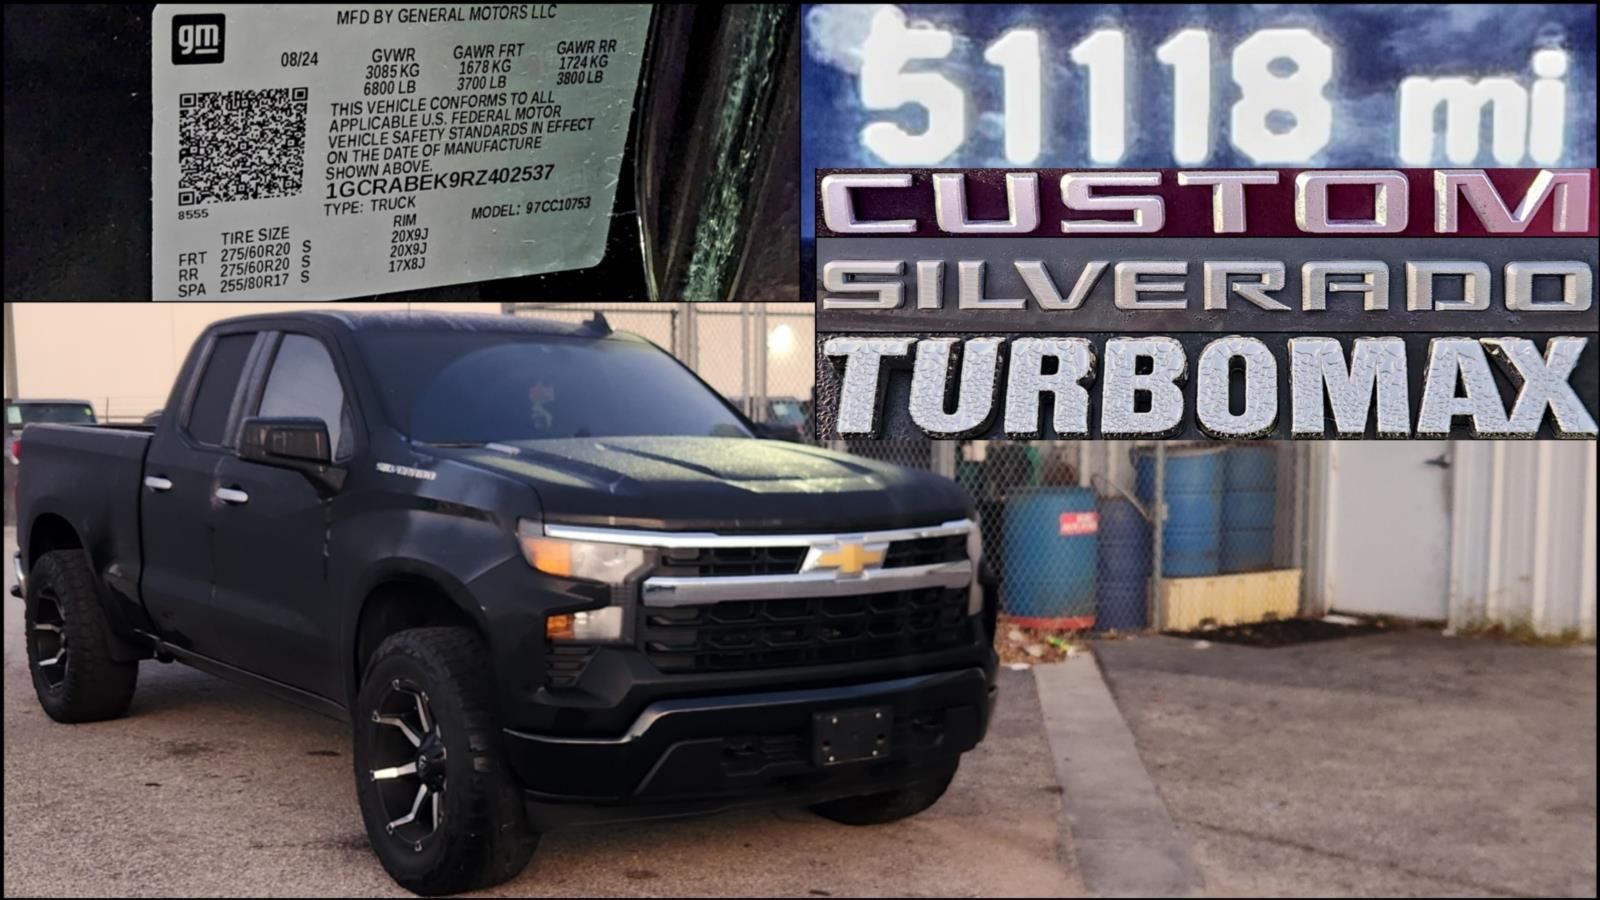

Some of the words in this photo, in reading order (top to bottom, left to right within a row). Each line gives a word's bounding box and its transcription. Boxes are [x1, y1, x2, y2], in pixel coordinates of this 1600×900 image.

[337, 10, 370, 25] MFD
[373, 9, 394, 24] BY
[398, 7, 465, 23] GENERAL
[469, 5, 528, 21] MOTORS
[531, 4, 557, 19] LLC
[178, 24, 219, 55] gm
[557, 40, 595, 55] GAWR
[598, 39, 617, 54] RR
[281, 51, 319, 67] 08/24
[372, 48, 416, 63] GVWR
[453, 44, 495, 59] GAWR
[498, 43, 525, 58] FRT
[365, 64, 398, 79] 3085
[400, 63, 420, 78] KG
[459, 60, 489, 75] 1678
[492, 59, 512, 73] KG
[559, 56, 588, 70] 1724
[590, 54, 609, 69] KG
[363, 81, 395, 96] 6800
[398, 80, 416, 94] LB
[457, 76, 487, 91] 3700
[489, 75, 507, 89] LB
[556, 71, 585, 86] 3800
[587, 70, 603, 84] LB
[861, 15, 1334, 166] 51118
[1399, 49, 1567, 166] mi
[330, 101, 363, 117] THIS
[367, 98, 427, 114] VEHICLE
[430, 93, 507, 110] CONFORMS
[511, 91, 528, 105] TO
[530, 90, 555, 104] ALL
[329, 114, 418, 133] APPLICABLE
[421, 112, 448, 127] U.S.
[451, 109, 511, 124] FEDERAL
[515, 105, 562, 120] MOTOR
[328, 131, 389, 149] VEHICLE
[392, 128, 445, 144] SAFETY
[449, 122, 528, 140] STANDARDS
[531, 121, 543, 134] IN
[547, 118, 595, 133] EFFECT
[327, 150, 348, 165] ON
[352, 148, 380, 162] THE
[383, 145, 419, 160] DATE
[422, 144, 441, 157] OF
[444, 136, 542, 155] MANUFACTURE
[325, 164, 379, 180] SHOWN
[382, 160, 433, 176] ABOVE.
[326, 164, 555, 199] 1GCRABEK9RZ402537
[324, 201, 364, 216] TYPE:
[371, 195, 417, 211] TRUCK
[471, 204, 521, 220] MODEL:
[526, 196, 592, 214] 97CC10753
[820, 169, 1591, 233] CUSTOM
[178, 209, 209, 220] 8555
[393, 213, 417, 227] RIM
[221, 229, 254, 245] TIRE
[258, 226, 290, 241] SIZE
[179, 251, 208, 266] FRT
[220, 242, 291, 262] 275/60R20
[302, 240, 312, 253] S
[391, 228, 429, 243] 20X9J
[178, 268, 199, 282] RR
[220, 257, 290, 277] 275/60R20
[301, 255, 311, 268] S
[390, 242, 428, 258] 20X9J
[178, 283, 207, 298] SPA
[220, 273, 289, 293] 255/80R17
[300, 270, 310, 283] S
[388, 257, 426, 273] 17X8J
[823, 259, 1593, 311] SILVERADO
[824, 336, 1598, 439] TURBOMAX
